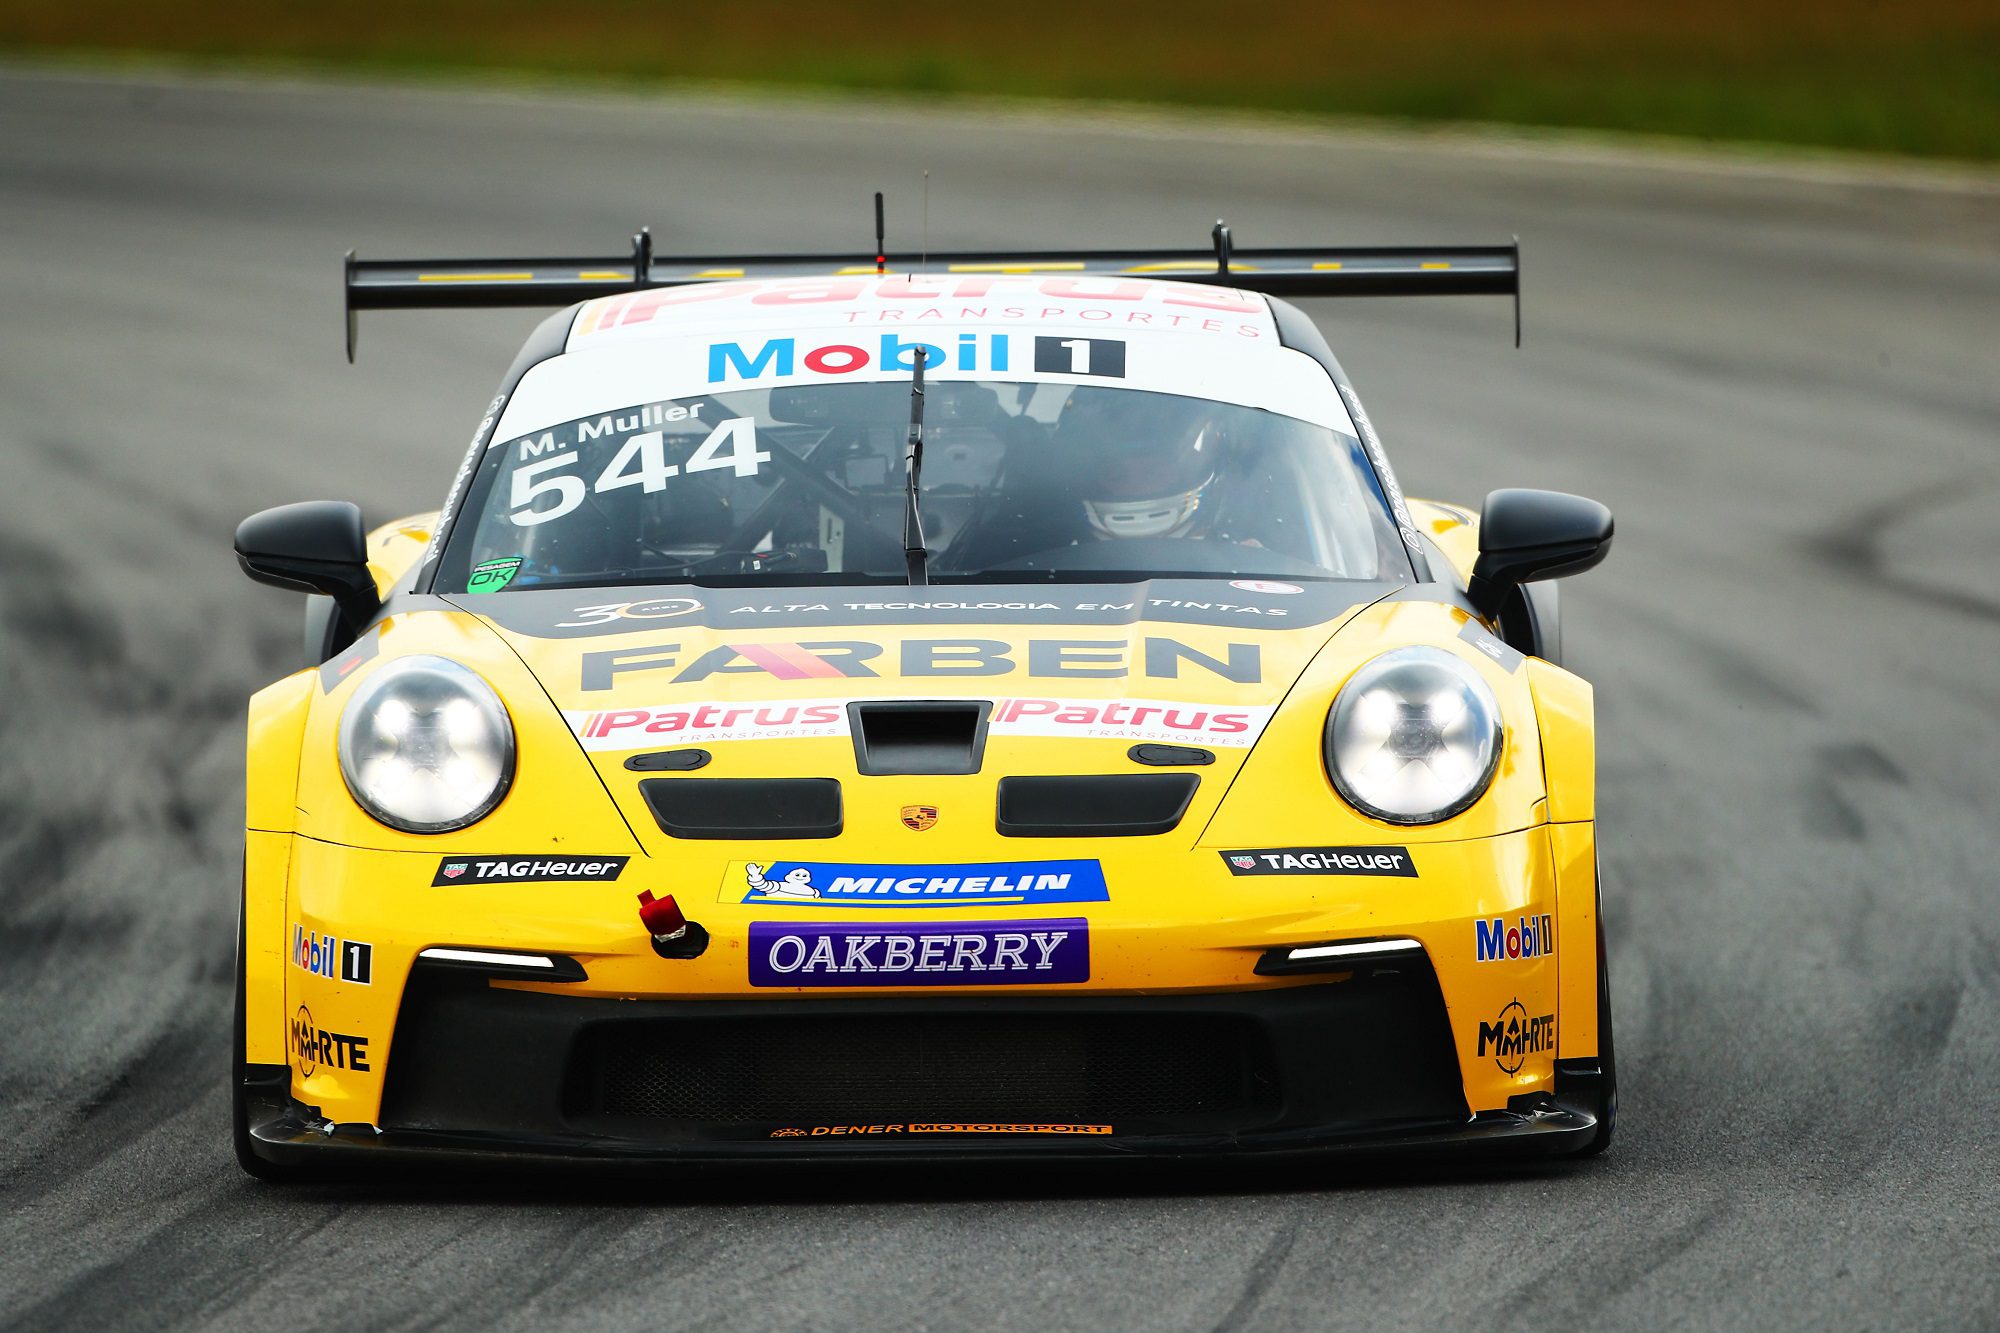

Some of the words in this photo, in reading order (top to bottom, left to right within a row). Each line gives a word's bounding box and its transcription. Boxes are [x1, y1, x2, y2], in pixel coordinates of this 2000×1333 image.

[844, 307, 1261, 338] TRANSPORTES
[708, 333, 1009, 383] Mobil
[519, 432, 566, 461] M.
[578, 403, 704, 443] Muller
[509, 416, 771, 527] 544
[470, 569, 514, 586] OK
[730, 603, 831, 614] ALTA
[843, 602, 1061, 611] TECNOLOGIA
[1074, 602, 1135, 611] EM
[1147, 599, 1289, 617] TINTAS
[581, 637, 1262, 691] FARBEN
[599, 705, 841, 738] Patrus
[1004, 699, 1249, 734] Patrus
[678, 728, 838, 742] TRANSPORTES
[1086, 728, 1247, 745] TRANSPORTES
[827, 873, 1072, 894] MICHELIN
[293, 922, 335, 979] Mobil
[768, 931, 1069, 973] OAKBERRY
[1475, 915, 1540, 962] Mobil
[811, 1124, 904, 1136] DENER
[912, 1123, 1109, 1134] MOTORSPORT
